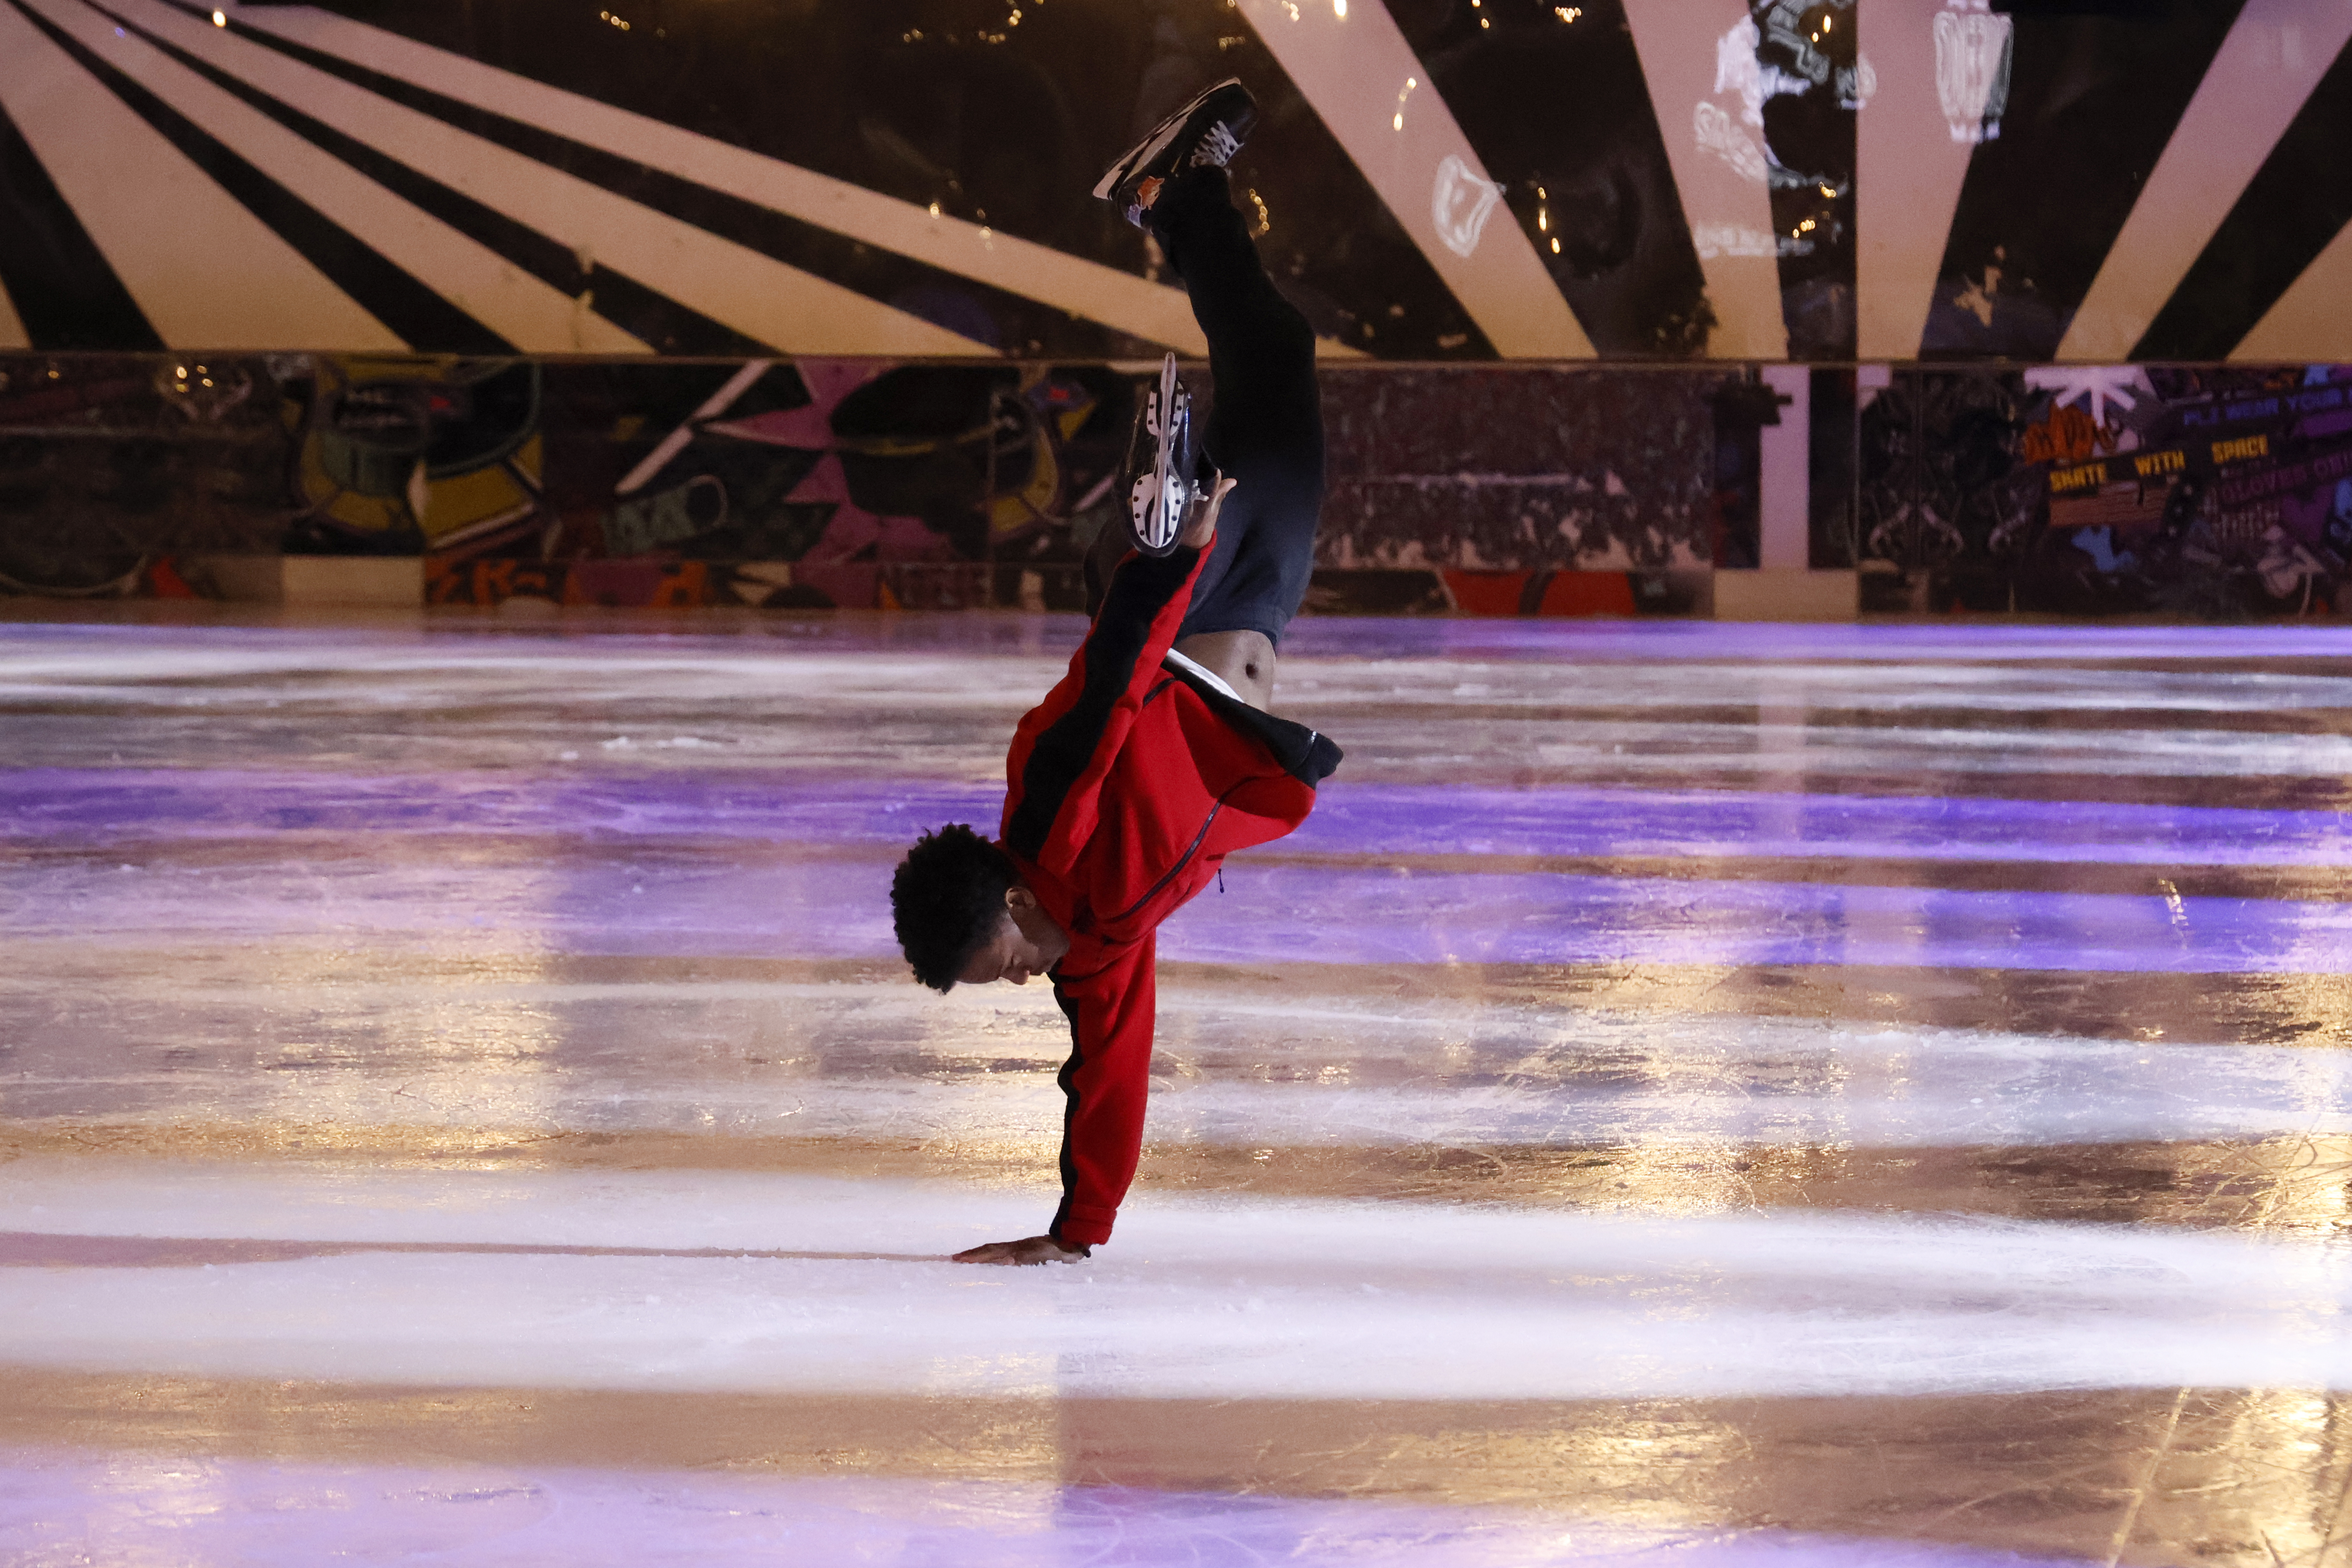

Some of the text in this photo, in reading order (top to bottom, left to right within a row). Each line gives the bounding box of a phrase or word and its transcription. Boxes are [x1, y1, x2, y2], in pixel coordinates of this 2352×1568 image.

[2049, 434, 2268, 491] SKATE WITH SPACE
